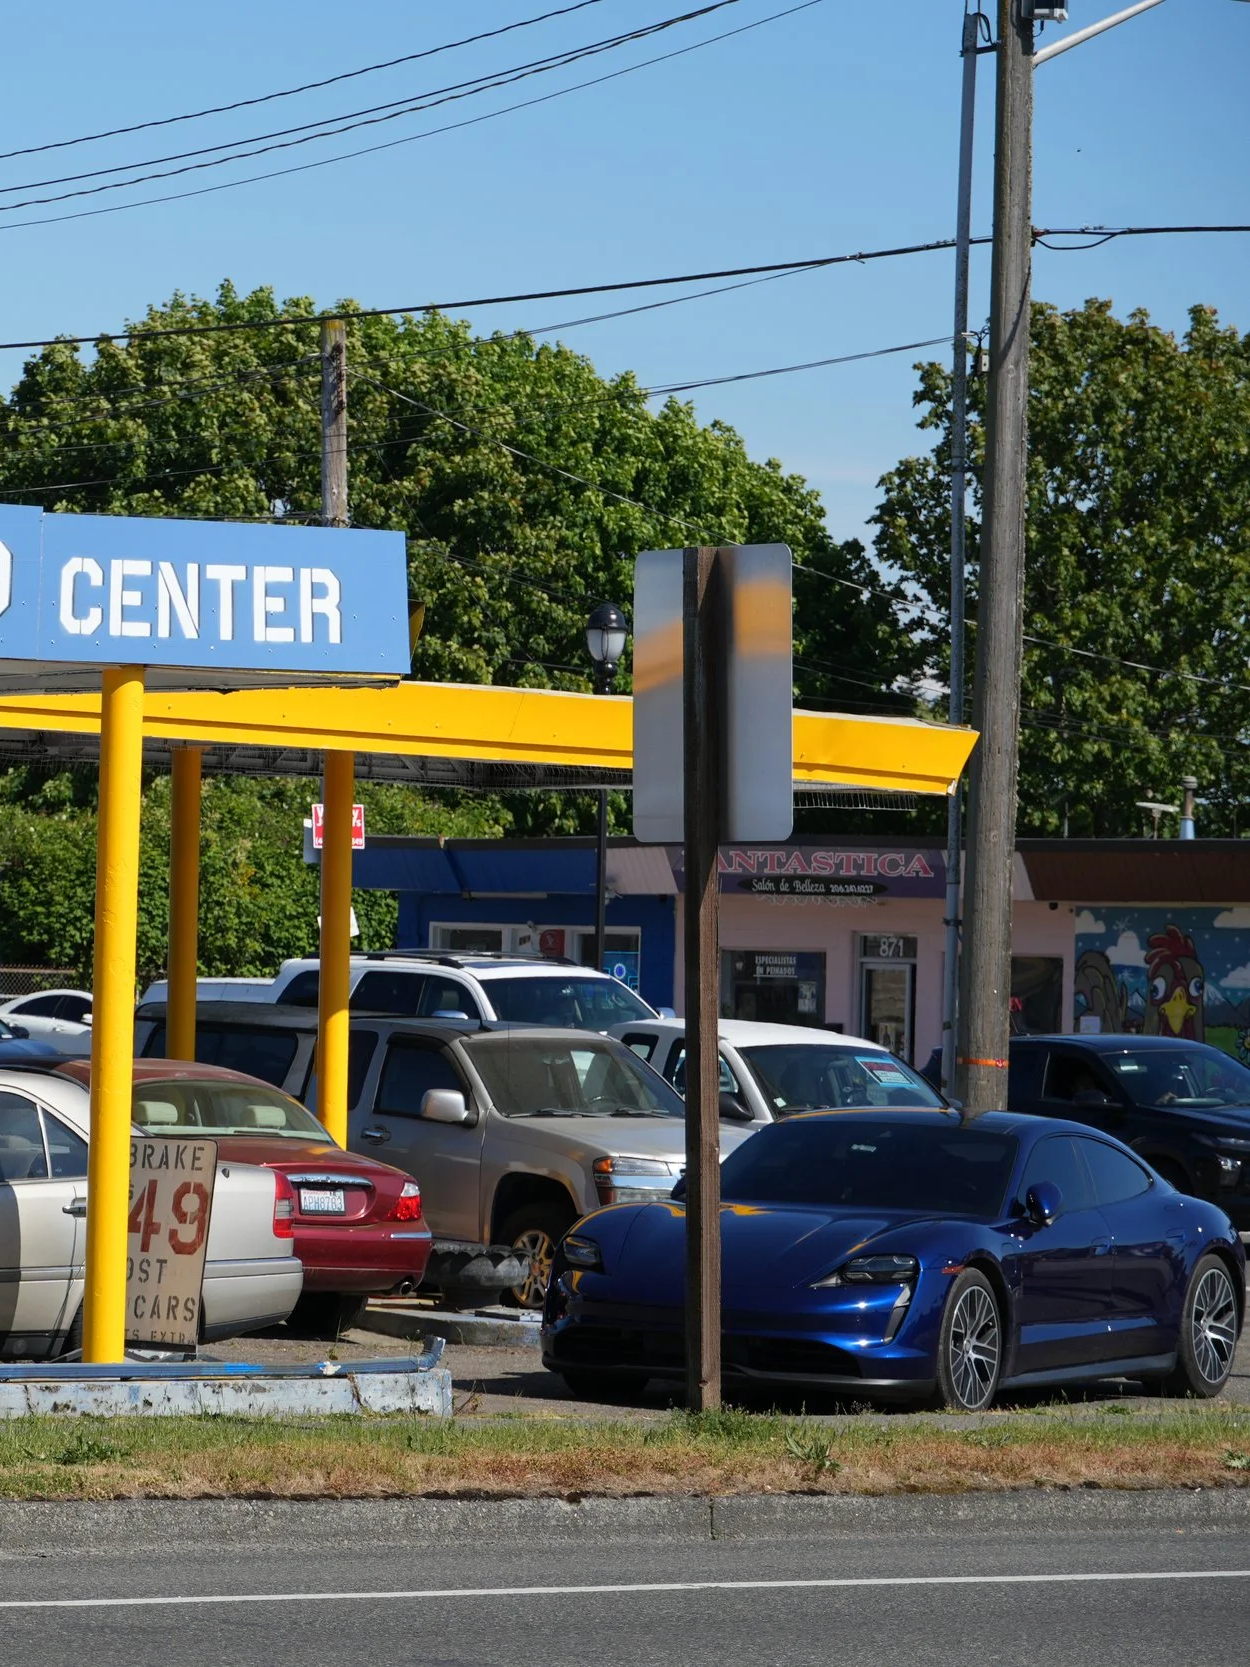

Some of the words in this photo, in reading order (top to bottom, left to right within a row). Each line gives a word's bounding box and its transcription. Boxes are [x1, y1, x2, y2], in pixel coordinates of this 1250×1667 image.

[59, 556, 343, 645] CENTER
[717, 850, 935, 878] ANTASTICA
[779, 878, 790, 892] de
[793, 878, 826, 893] Belleza
[879, 938, 904, 957] 871
[126, 1258, 168, 1285] OST
[133, 1294, 196, 1322] CARS
